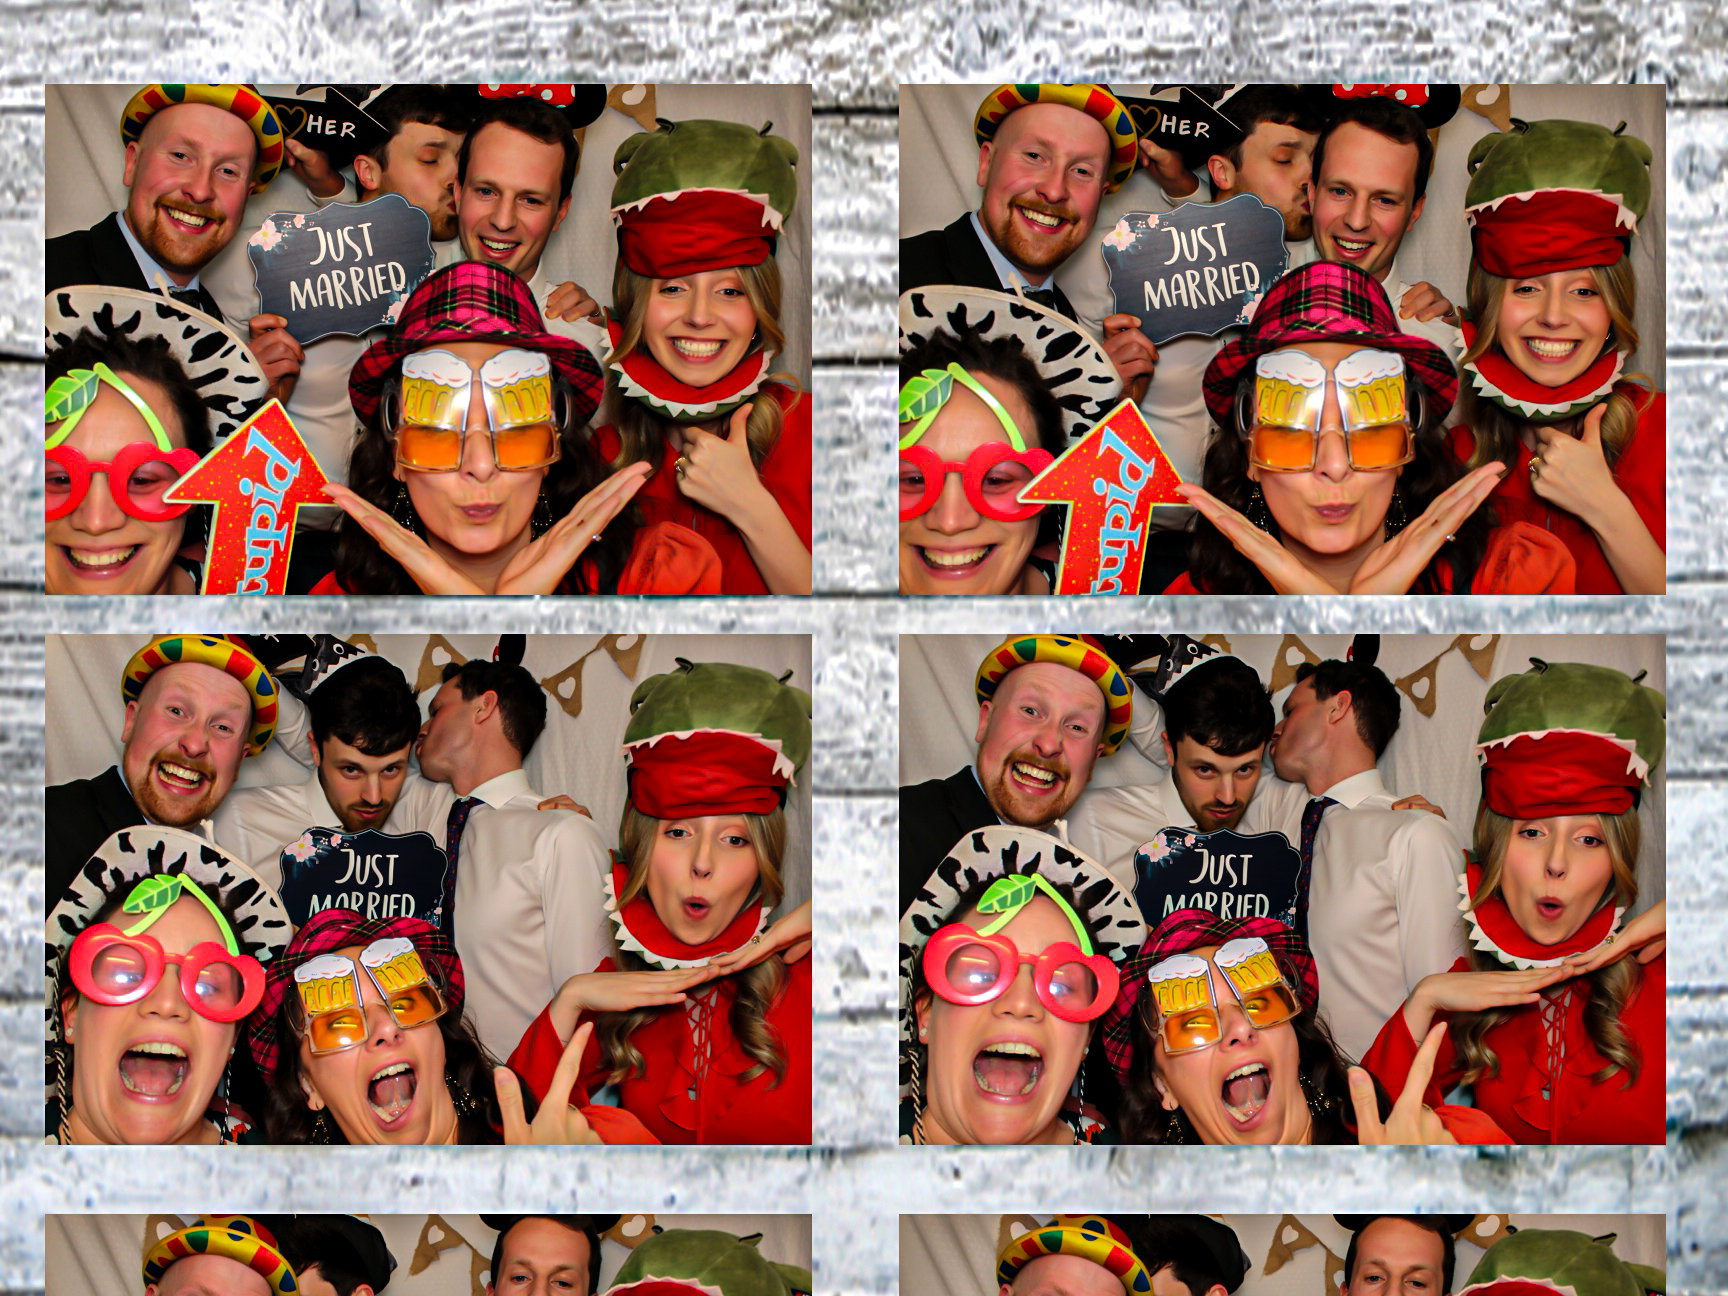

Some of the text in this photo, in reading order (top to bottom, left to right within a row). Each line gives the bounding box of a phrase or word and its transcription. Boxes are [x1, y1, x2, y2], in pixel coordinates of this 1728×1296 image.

[306, 113, 356, 138] HER
[1160, 113, 1210, 138] HER
[306, 222, 373, 265] JUST
[1160, 222, 1227, 265] JUST
[289, 261, 407, 312] MARRIED
[1143, 261, 1261, 312] MARRIED
[334, 848, 400, 889] JUST
[1188, 848, 1254, 889] JUST
